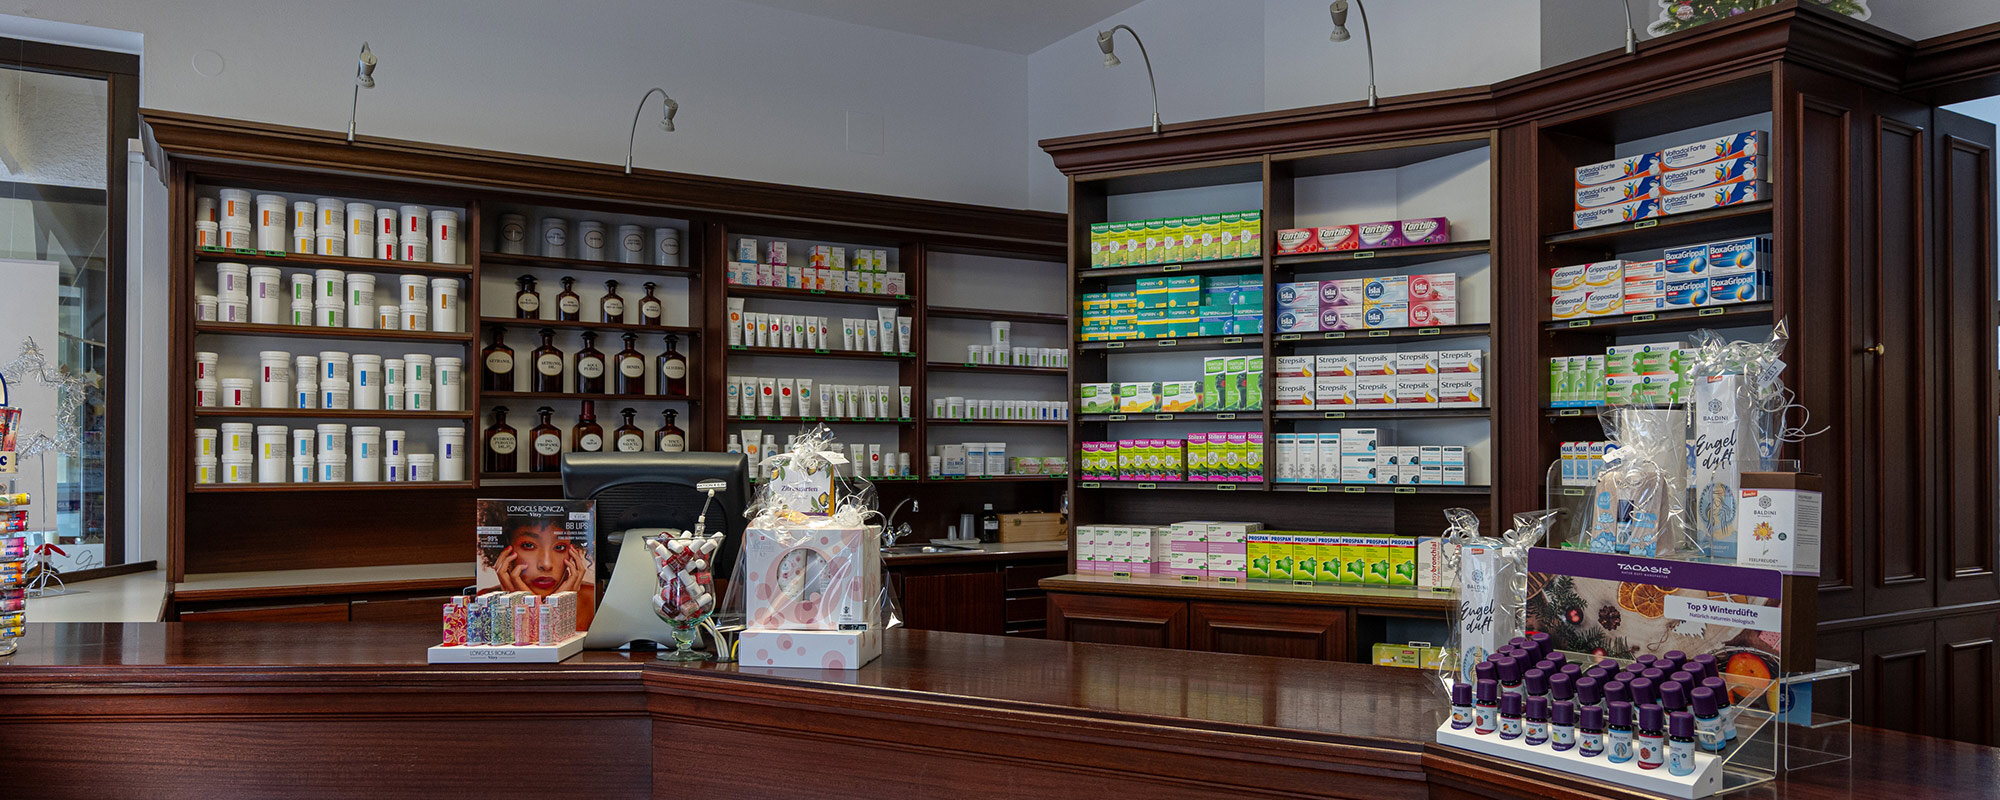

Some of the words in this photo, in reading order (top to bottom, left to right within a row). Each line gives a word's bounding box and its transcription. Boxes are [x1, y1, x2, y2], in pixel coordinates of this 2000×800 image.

[1665, 147, 1689, 156] Voltadol
[1578, 166, 1600, 175] Voltadol
[1665, 171, 1688, 180] Voltadol
[1578, 189, 1600, 197] Voltadol
[1664, 195, 1688, 204] Voltadol
[1577, 210, 1598, 218] Voltadol
[1710, 242, 1753, 254] BoxaGrippal
[1666, 249, 1705, 260] BoxaGrippal
[1589, 264, 1618, 273] Grippostad
[1555, 269, 1583, 278] Grippostad
[1711, 275, 1753, 287] BoxaGrippal
[1667, 281, 1706, 291] BoxaGrippal
[1555, 297, 1583, 305] Grippostad
[1590, 293, 1619, 301] Grippostad
[1696, 429, 1737, 457] Engel
[1702, 448, 1734, 469] duft
[1617, 563, 1671, 574] TAOASIS
[1461, 599, 1495, 621] Engel
[1687, 602, 1701, 612] Top
[1709, 604, 1758, 618] Winterdüfte
[1466, 616, 1493, 634] duft
